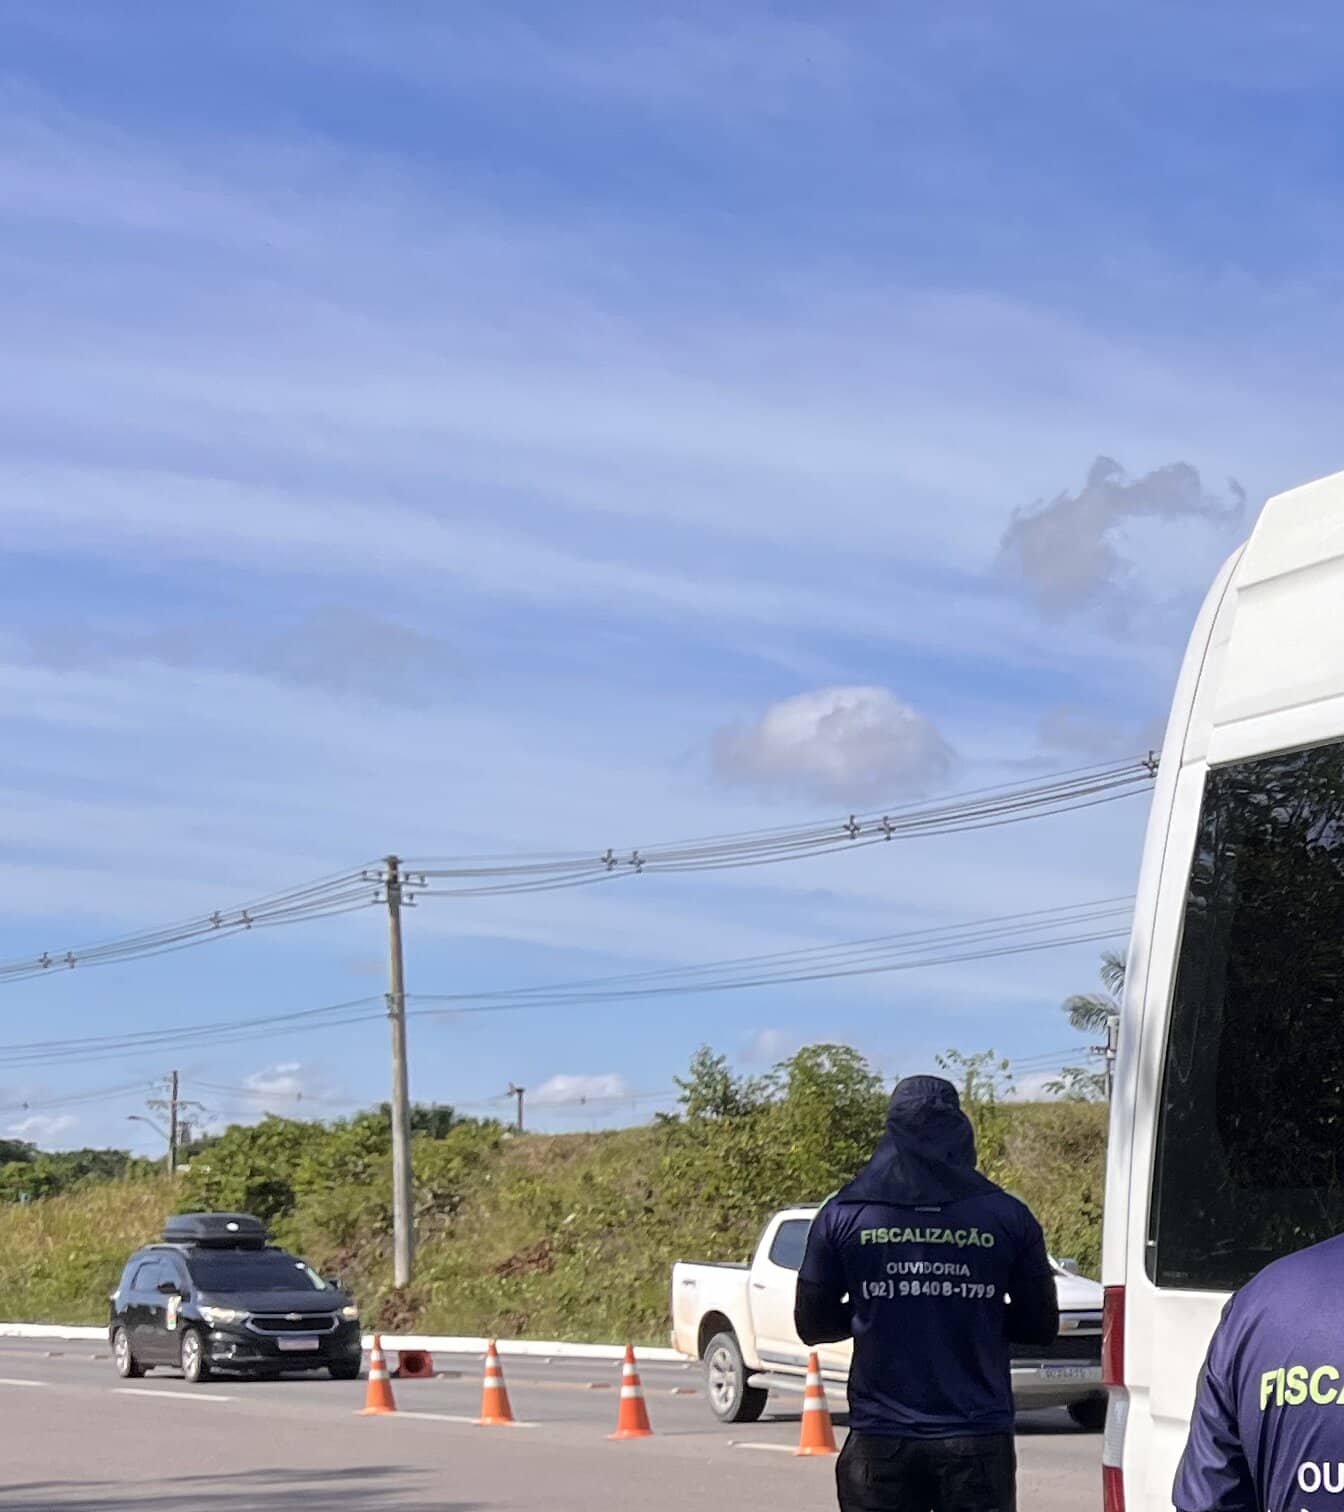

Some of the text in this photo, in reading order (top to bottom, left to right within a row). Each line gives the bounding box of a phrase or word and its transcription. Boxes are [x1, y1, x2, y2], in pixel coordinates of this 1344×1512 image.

[860, 1228, 994, 1248] FISCALIZAÇÃO
[886, 1262, 971, 1277] OUVIDORIA
[862, 1280, 996, 1299] (92) 98408-1799
